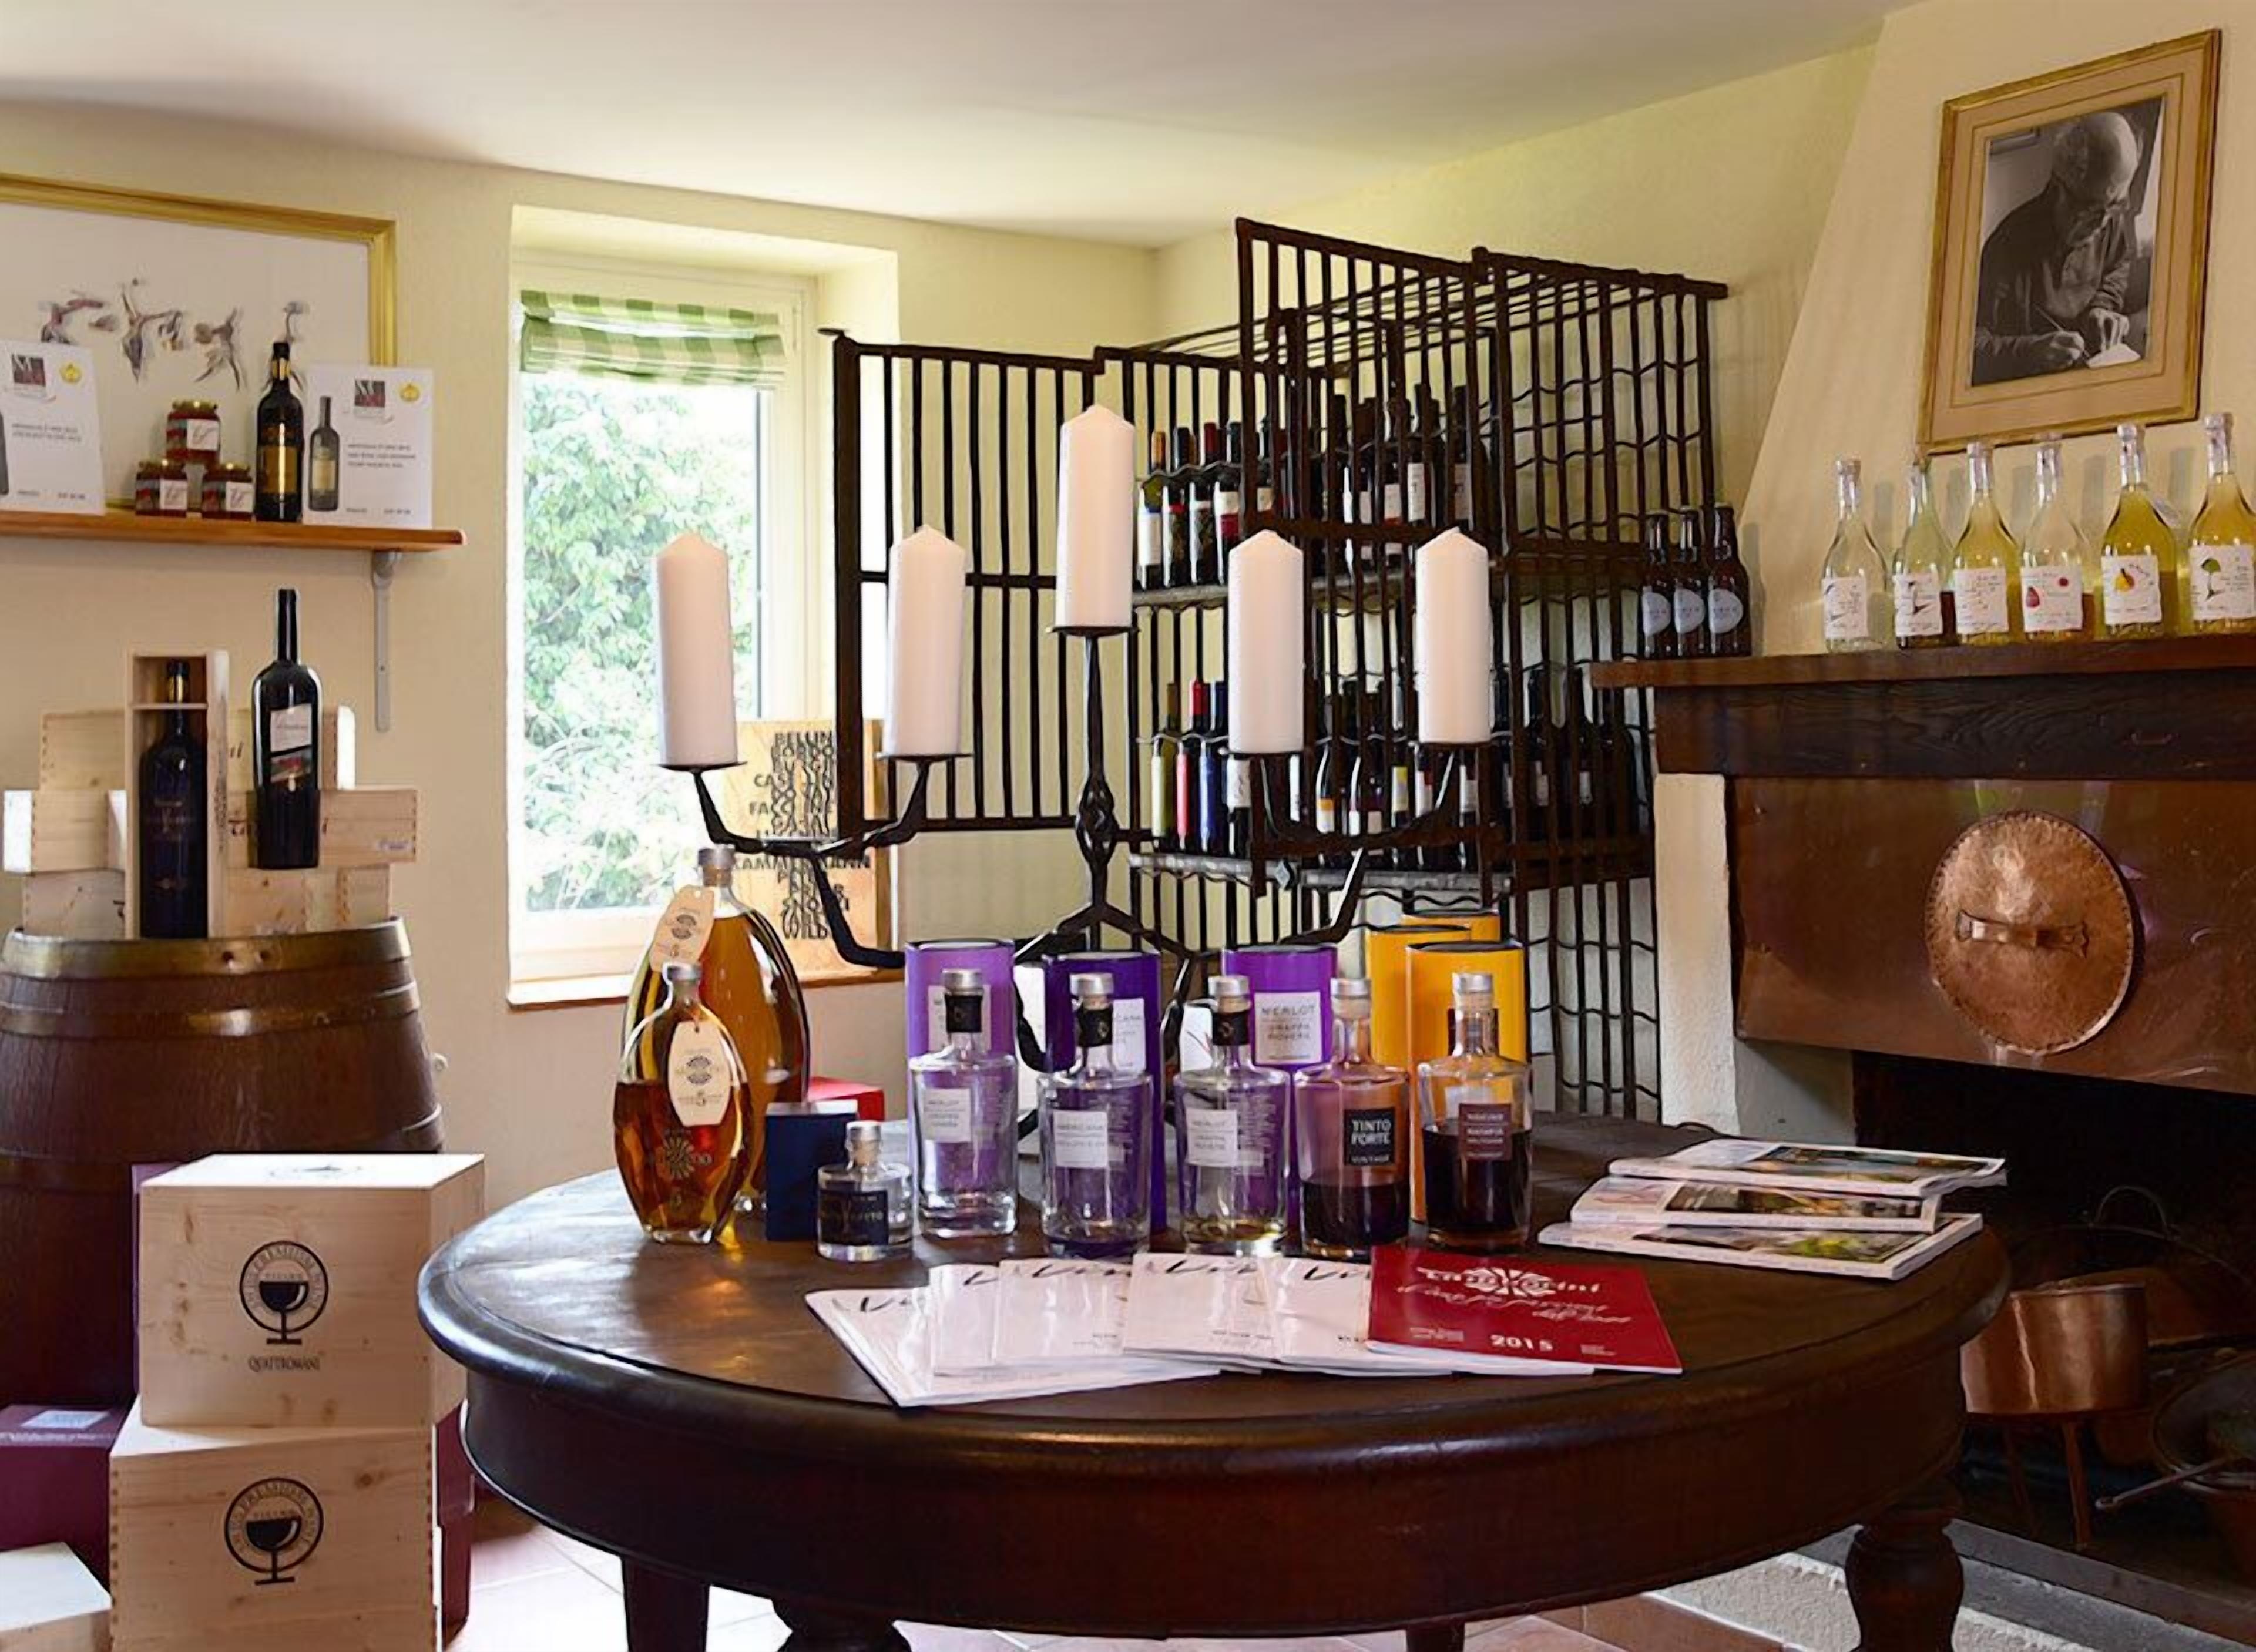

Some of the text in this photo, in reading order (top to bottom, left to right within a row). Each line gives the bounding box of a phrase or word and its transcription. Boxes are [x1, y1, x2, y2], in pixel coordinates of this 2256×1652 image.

[1261, 1004, 1315, 1016] MERLOT
[1351, 1119, 1392, 1131] TINTO
[1351, 1132, 1391, 1145] FORTE
[1489, 1334, 1554, 1352] 2015
